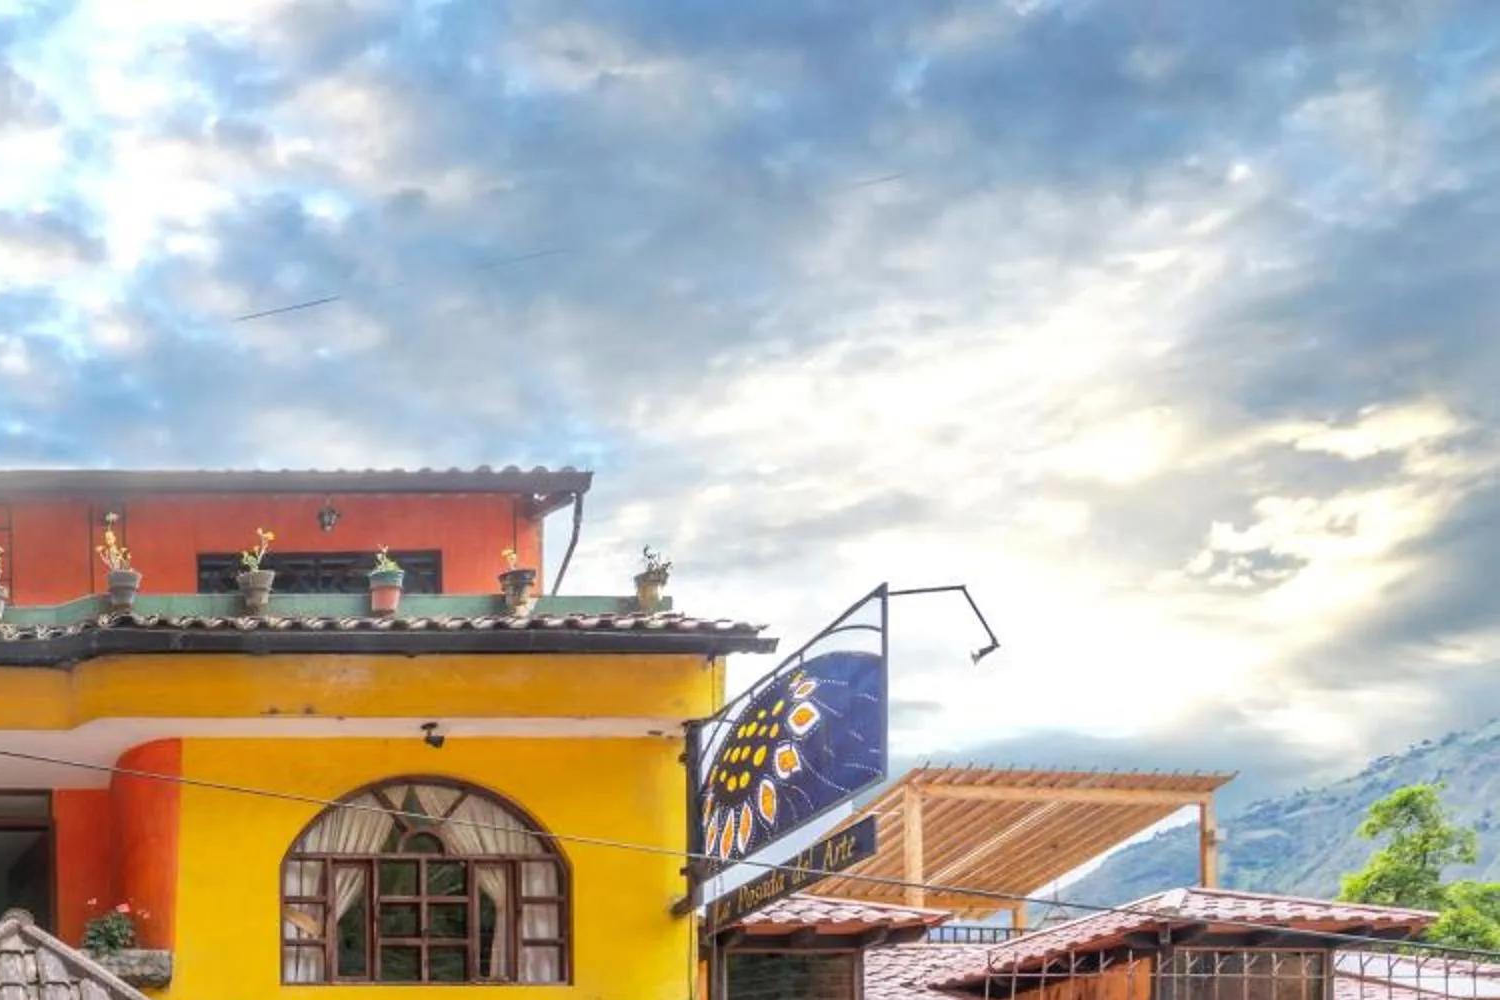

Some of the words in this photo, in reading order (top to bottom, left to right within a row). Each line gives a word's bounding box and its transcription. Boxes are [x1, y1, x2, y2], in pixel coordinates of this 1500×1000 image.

[738, 868, 785, 914] Posada
[792, 847, 813, 885] del
[823, 835, 856, 873] Arte
